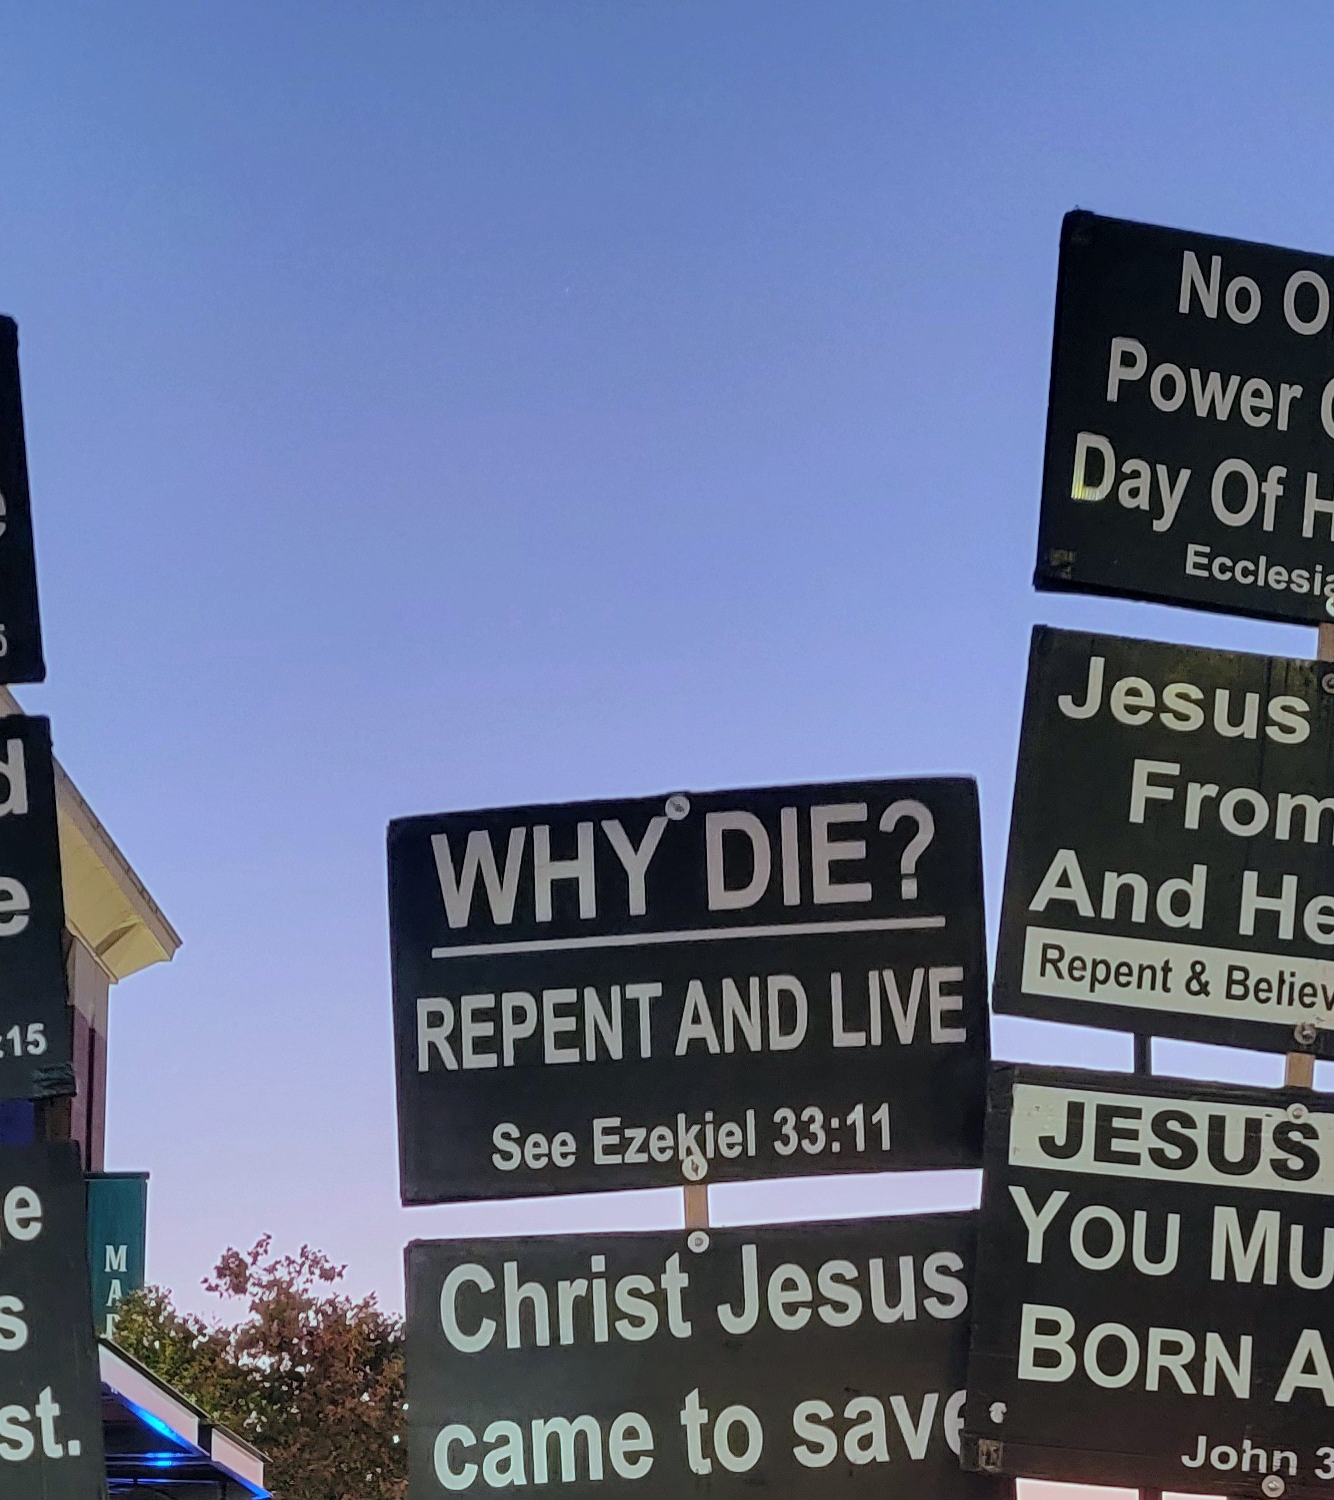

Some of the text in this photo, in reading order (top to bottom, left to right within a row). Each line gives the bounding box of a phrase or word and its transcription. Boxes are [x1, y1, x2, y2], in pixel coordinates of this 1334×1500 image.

[1178, 249, 1262, 326] No
[1106, 336, 1303, 431] Power
[1070, 432, 1192, 534] Day
[1210, 457, 1284, 532] Of
[1058, 655, 1311, 745] Jesus
[430, 799, 935, 929] WHY DIE?
[1028, 848, 1208, 931] And
[1039, 943, 1172, 996] Repent
[1184, 960, 1211, 997] &
[416, 966, 966, 1072] REPENT AND LIVE
[492, 1103, 892, 1171] See Ezekiel 33:11
[1038, 1100, 1321, 1181] JESUS
[1007, 1185, 1181, 1277] YOU
[439, 1243, 968, 1354] Christ Jesus
[1017, 1303, 1253, 1399] BORN
[433, 1409, 654, 1491] came
[679, 1387, 763, 1476] to
[1181, 1435, 1298, 1477] John
